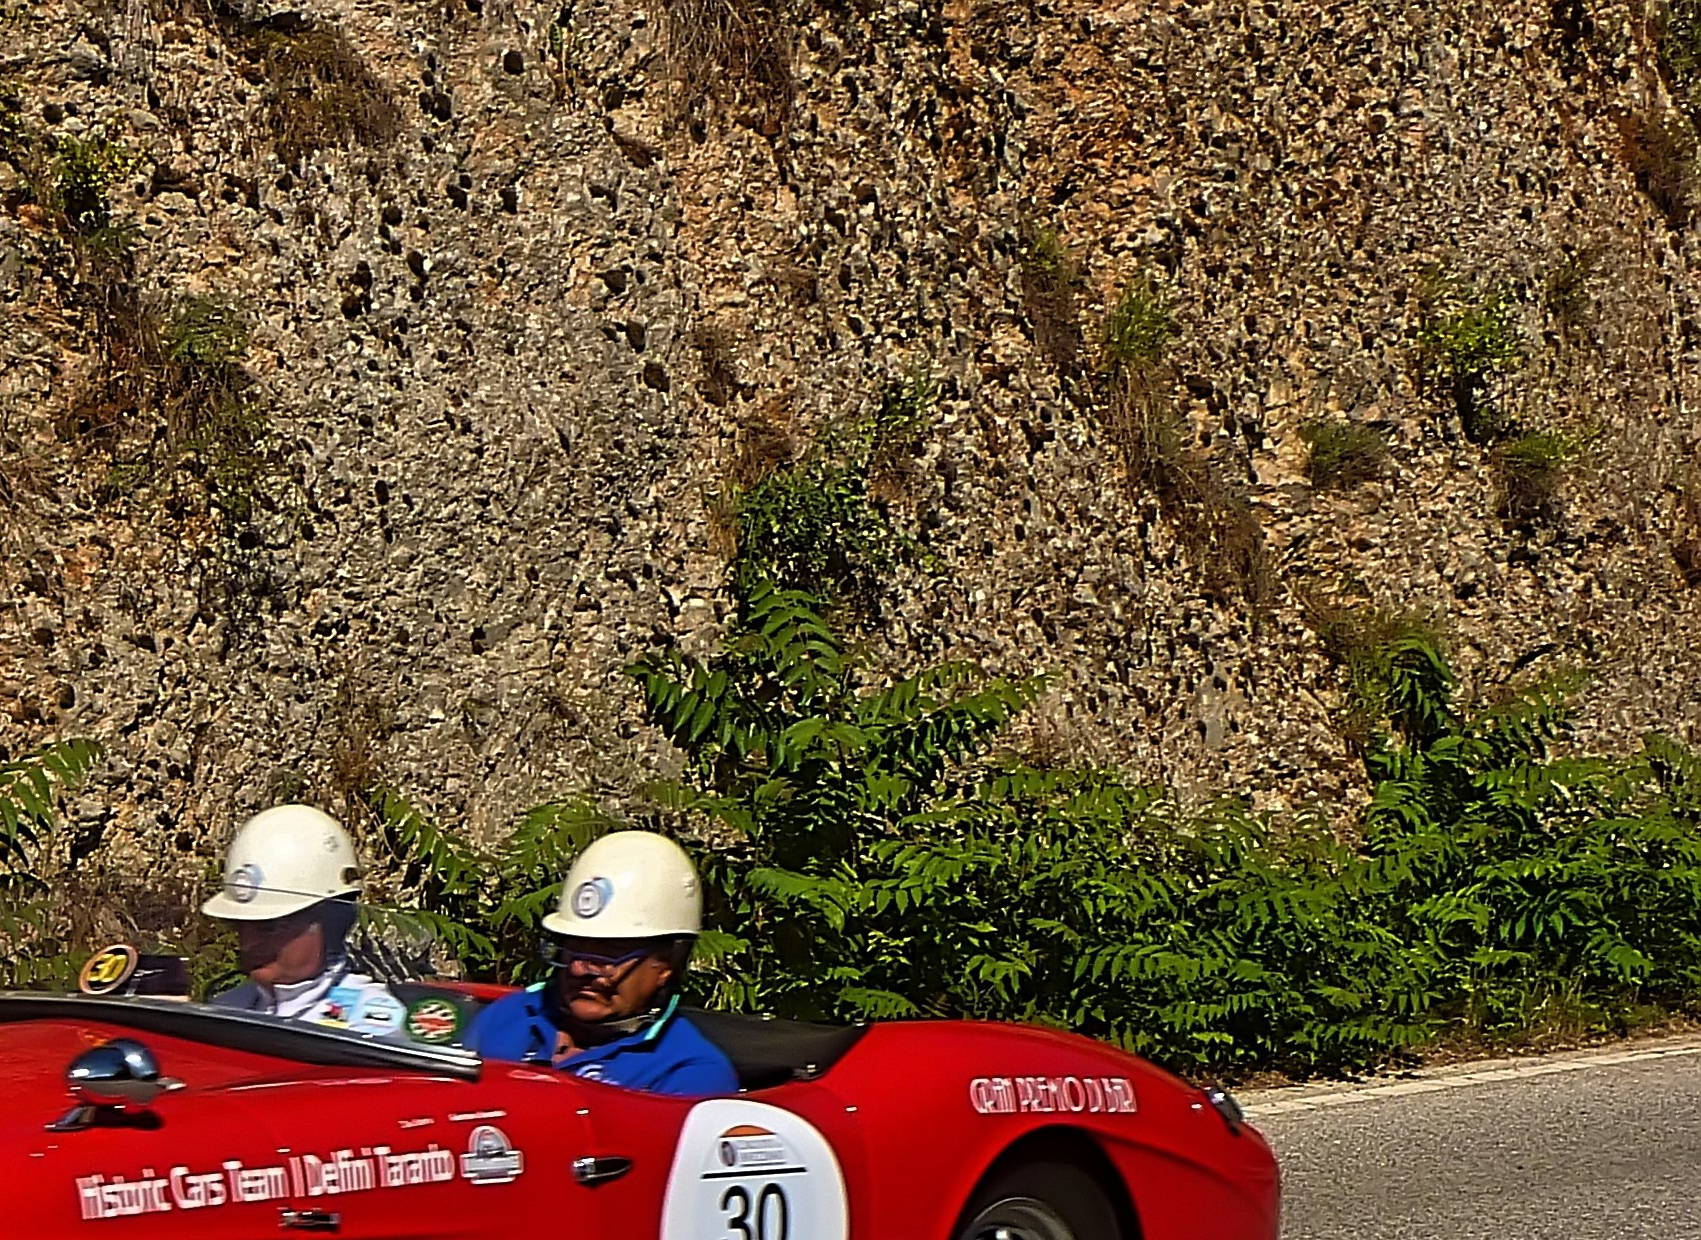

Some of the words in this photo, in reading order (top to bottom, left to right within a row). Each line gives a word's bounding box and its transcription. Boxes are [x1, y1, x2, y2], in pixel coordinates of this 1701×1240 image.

[76, 1168, 172, 1220] Historic
[170, 1166, 228, 1210] Cars
[222, 1160, 290, 1203] Team
[373, 1144, 456, 1188] Taranto
